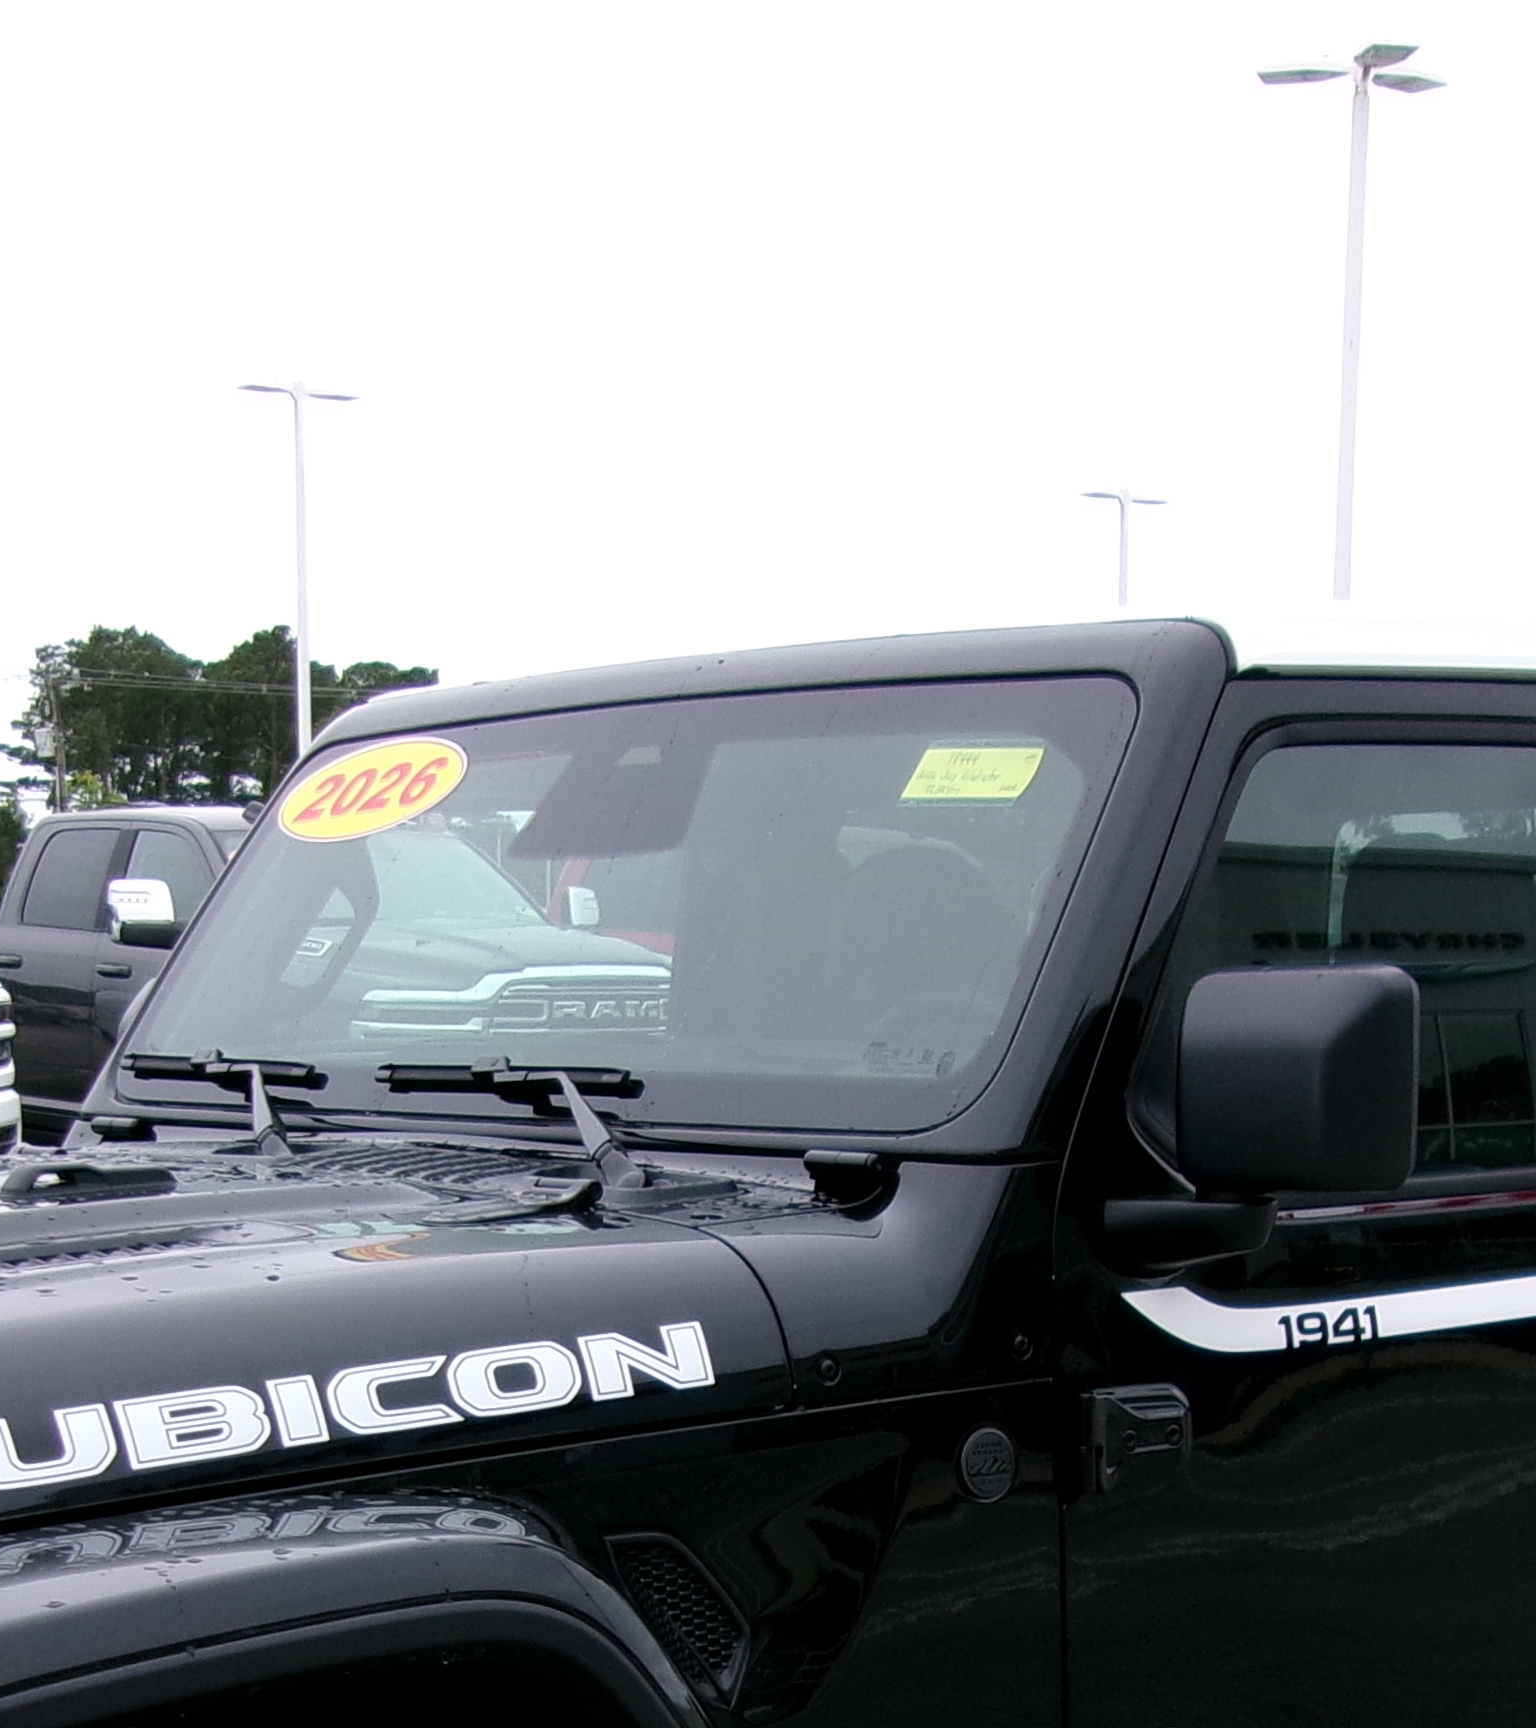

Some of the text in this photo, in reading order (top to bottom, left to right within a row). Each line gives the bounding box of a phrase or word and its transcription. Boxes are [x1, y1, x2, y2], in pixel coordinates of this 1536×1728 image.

[291, 756, 450, 825] 2026
[553, 999, 668, 1021] RAM
[1277, 1304, 1381, 1351] 1941
